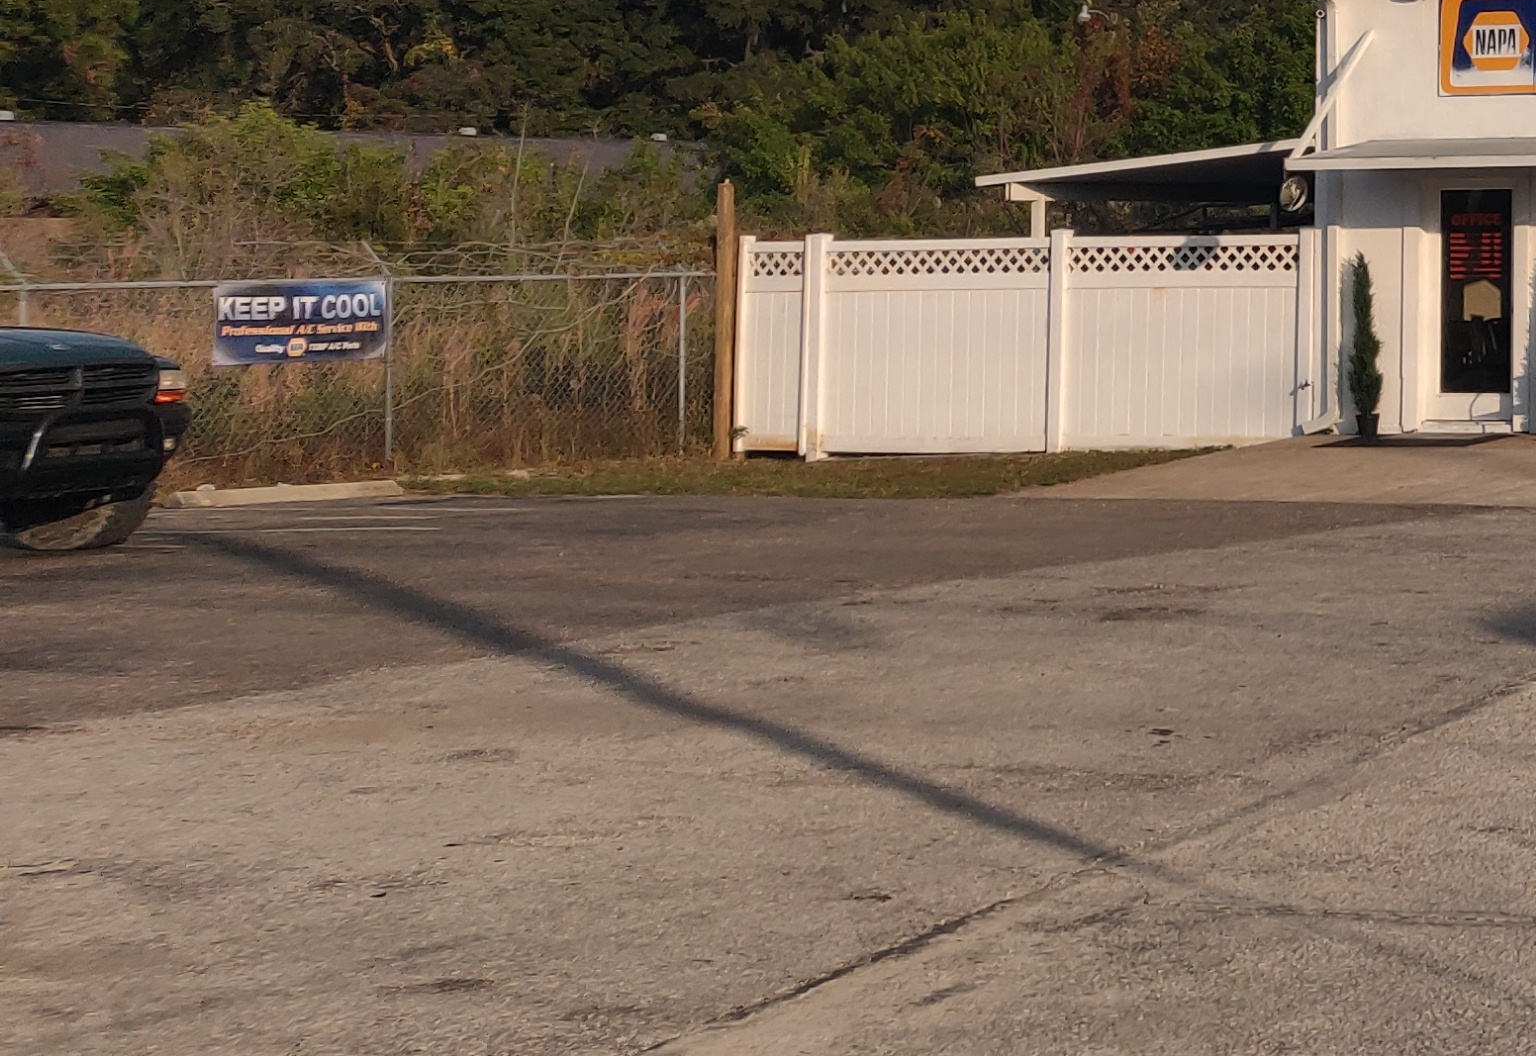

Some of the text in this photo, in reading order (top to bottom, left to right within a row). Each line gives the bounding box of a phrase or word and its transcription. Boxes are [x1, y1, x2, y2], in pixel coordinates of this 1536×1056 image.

[1474, 28, 1518, 56] NAPA
[218, 293, 382, 321] KEEP IT COOL
[221, 324, 295, 336] Professional
[316, 322, 353, 334] Service
